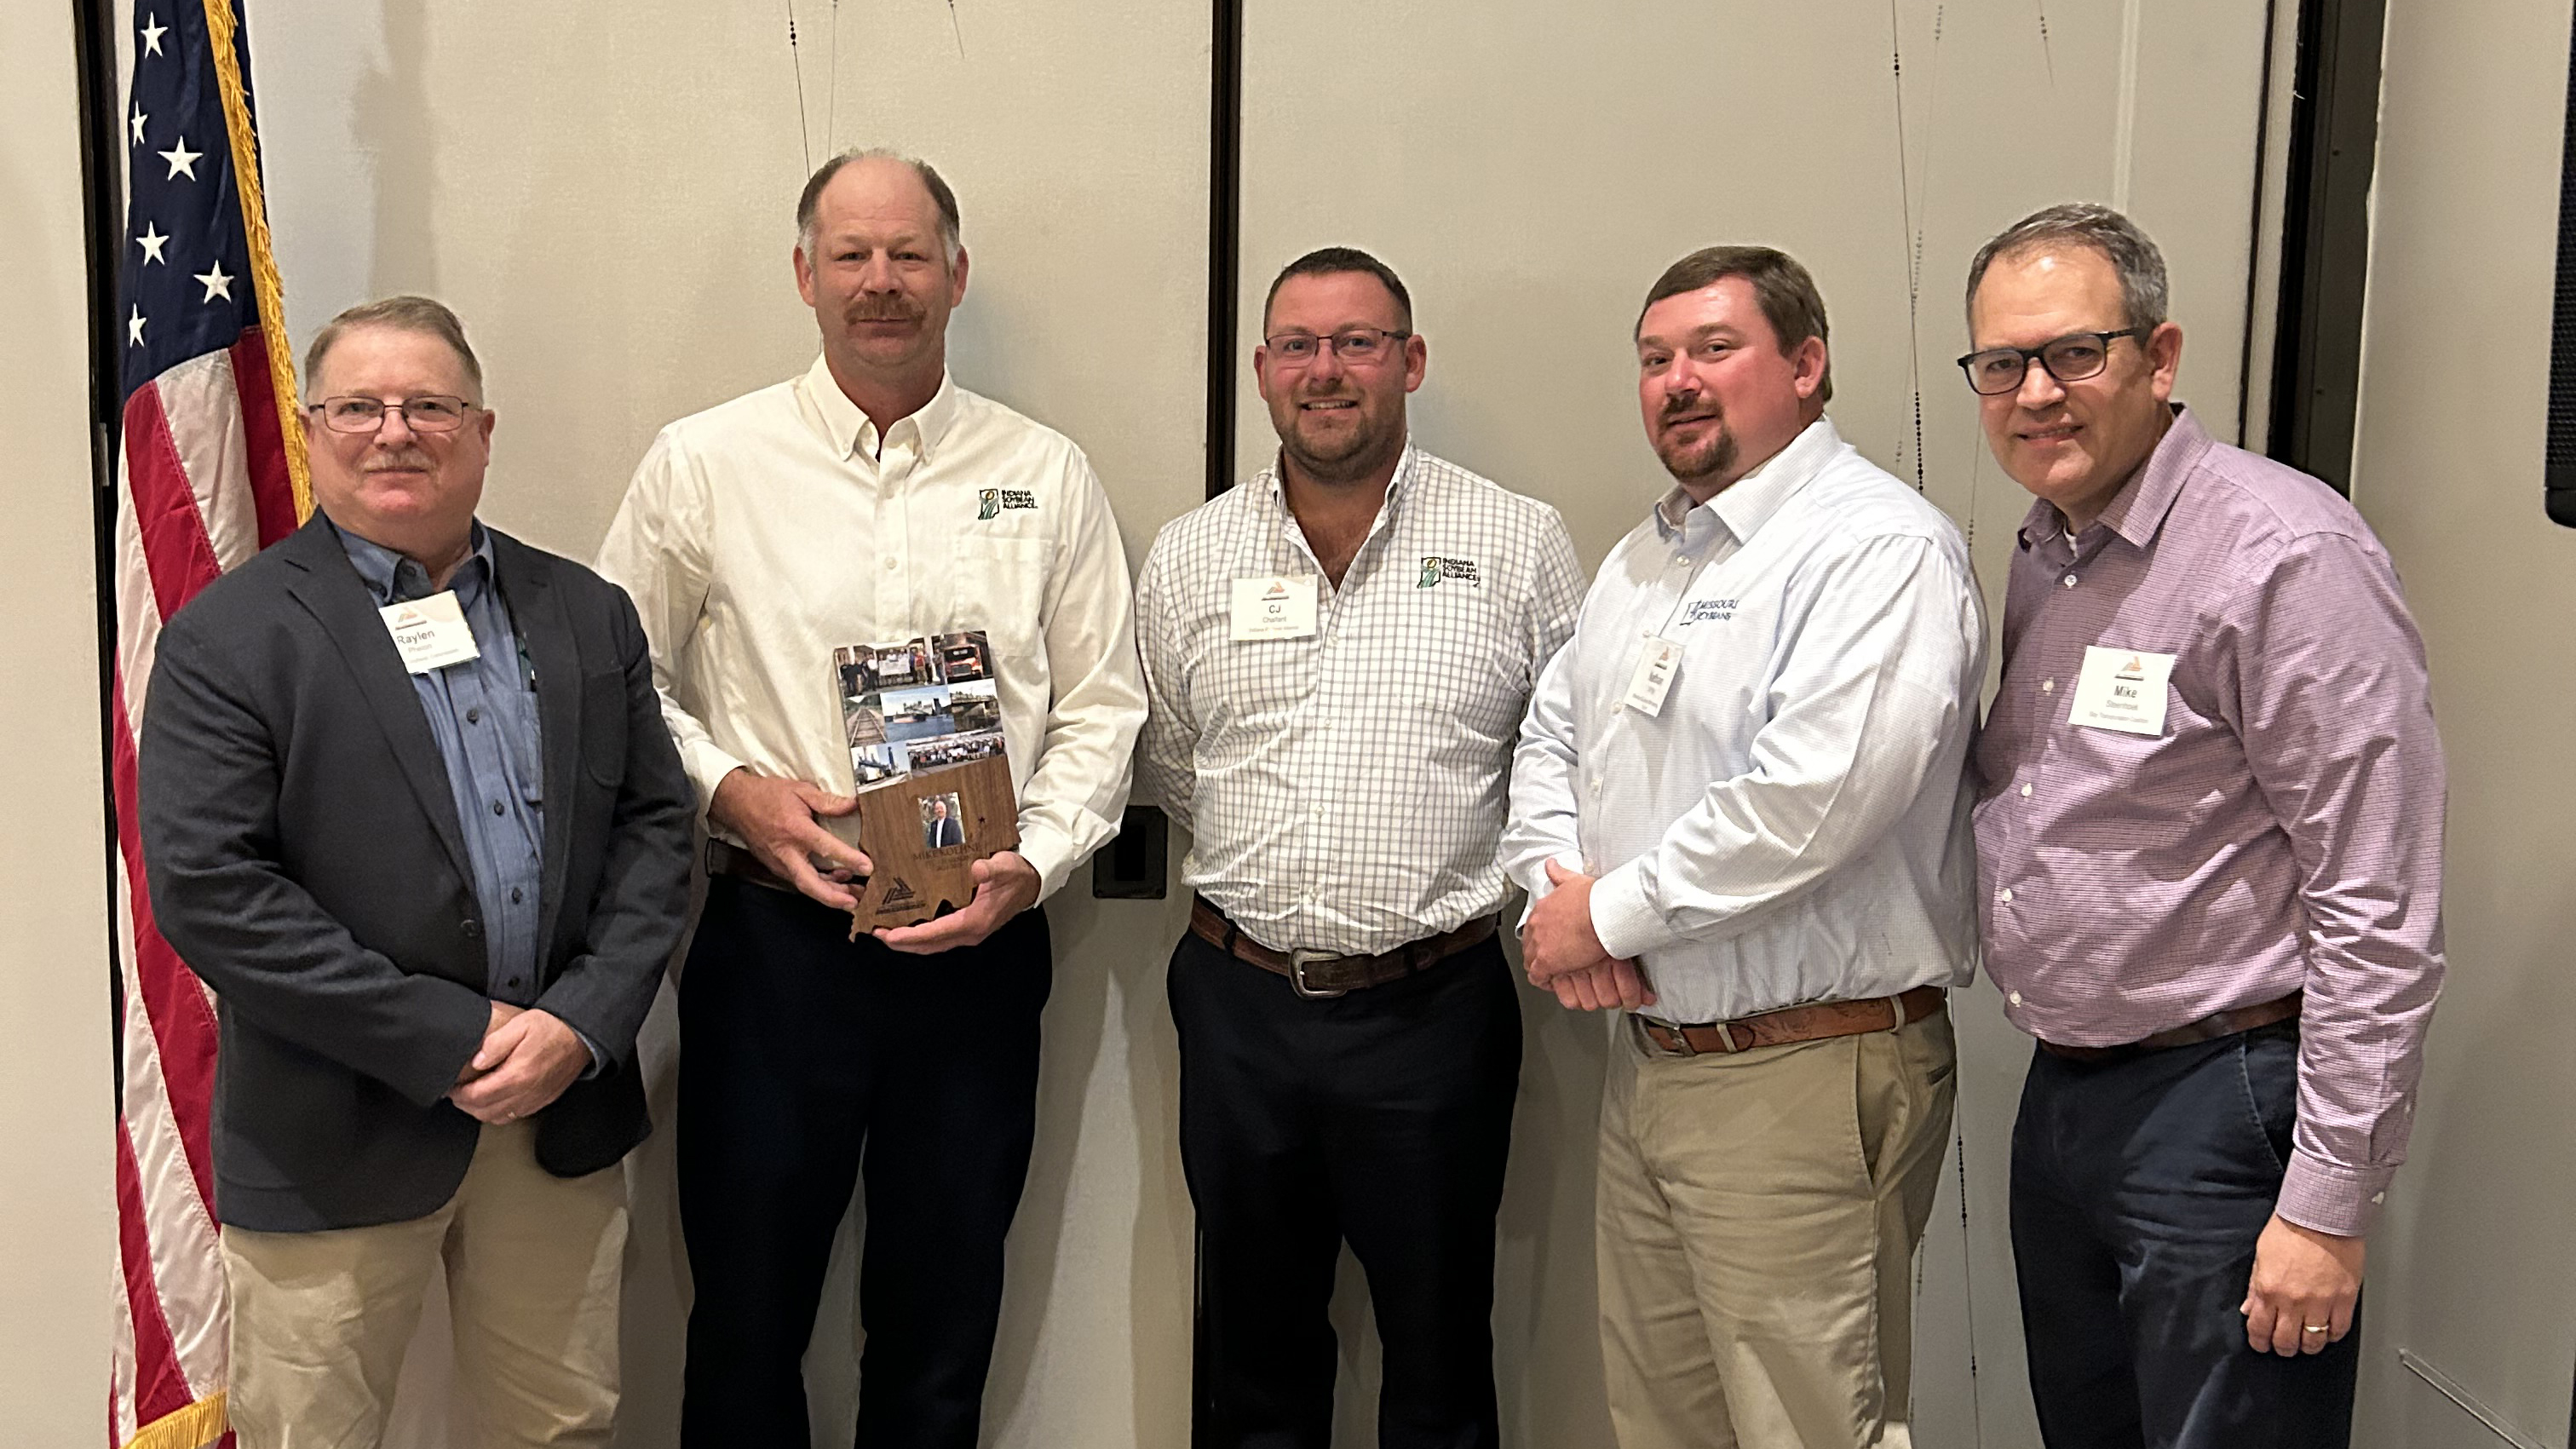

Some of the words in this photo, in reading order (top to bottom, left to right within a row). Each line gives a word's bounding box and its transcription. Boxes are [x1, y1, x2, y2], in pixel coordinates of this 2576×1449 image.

[1268, 605, 1282, 613] CJ
[397, 630, 435, 645] Raylen
[2114, 685, 2137, 699] Mike
